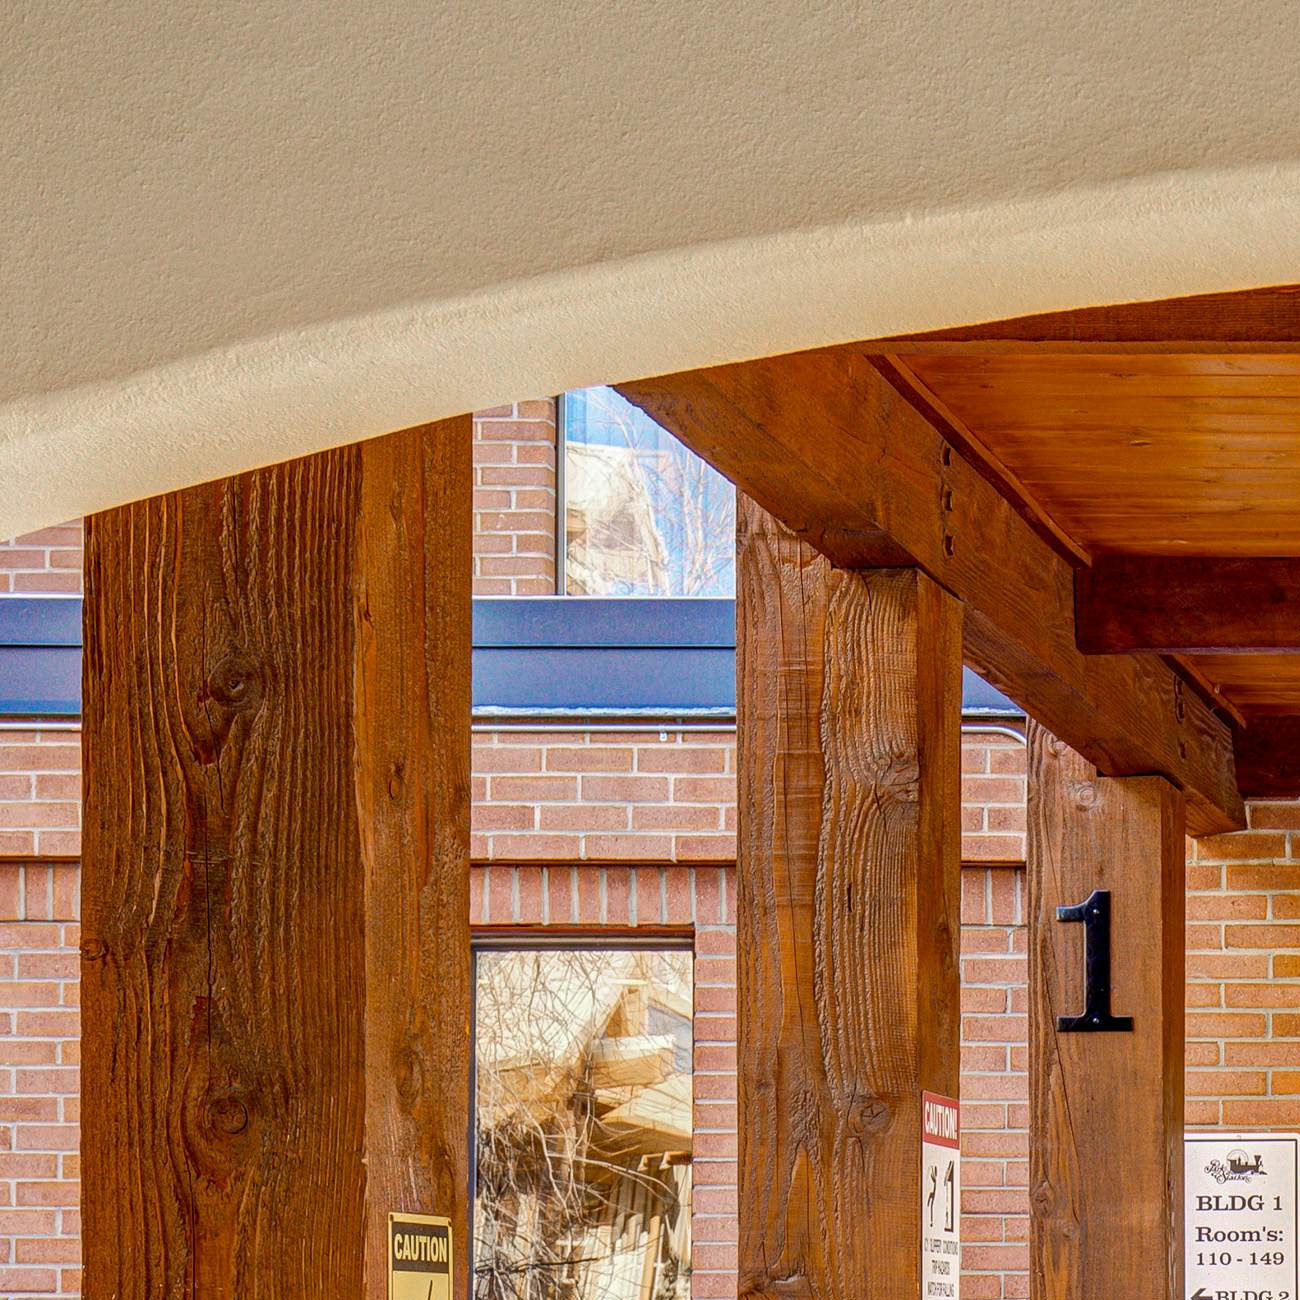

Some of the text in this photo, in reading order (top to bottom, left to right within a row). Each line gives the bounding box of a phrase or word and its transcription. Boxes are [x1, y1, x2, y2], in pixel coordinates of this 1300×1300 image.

[1056, 890, 1134, 1032] 1
[924, 1100, 958, 1140] CAUTION!
[1195, 1195, 1283, 1211] BLDG 1
[1195, 1226, 1284, 1242] Room's:
[394, 1233, 448, 1263] CAUTION
[1196, 1252, 1232, 1266] 110
[1249, 1251, 1285, 1266] 149
